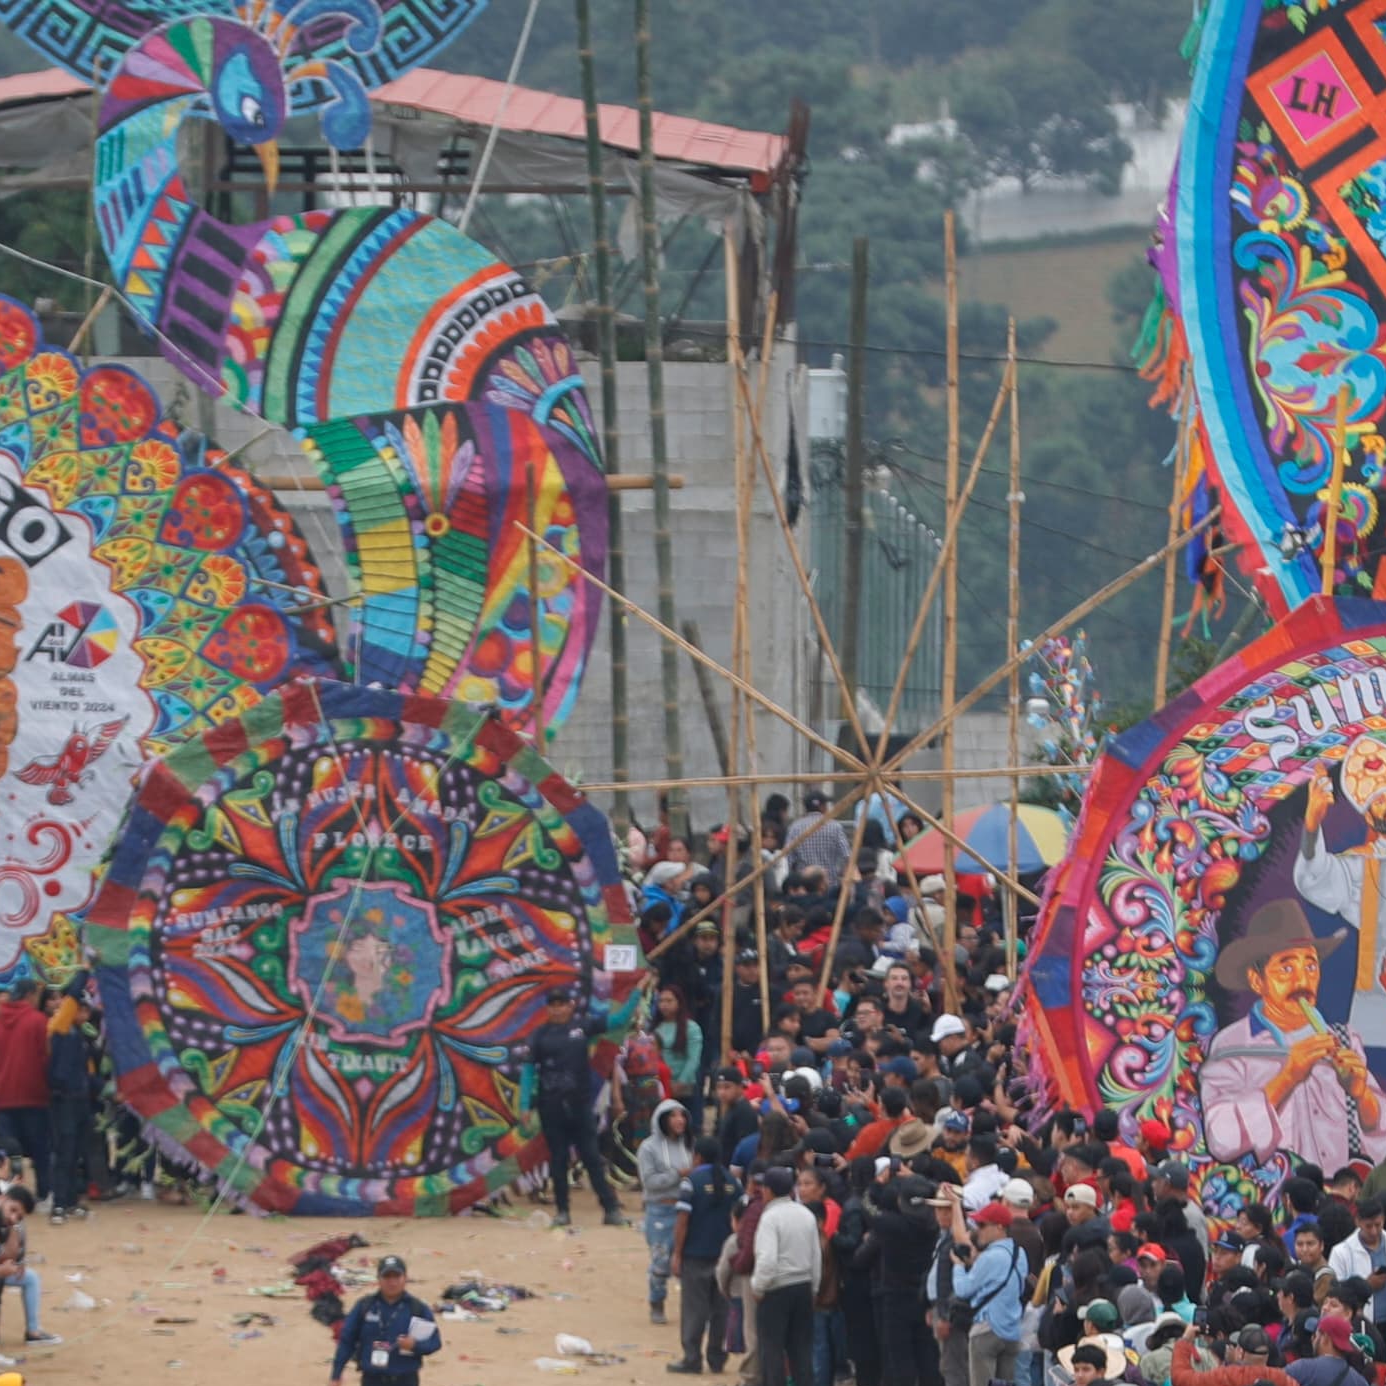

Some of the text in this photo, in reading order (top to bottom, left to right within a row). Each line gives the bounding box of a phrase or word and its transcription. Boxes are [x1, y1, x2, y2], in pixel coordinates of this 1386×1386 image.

[1288, 76, 1340, 119] LH
[50, 672, 96, 683] ALMAS
[60, 687, 85, 697] DEL
[30, 701, 116, 712] VIENTO 2024
[307, 781, 376, 808] MUJER
[613, 950, 631, 965] 27
